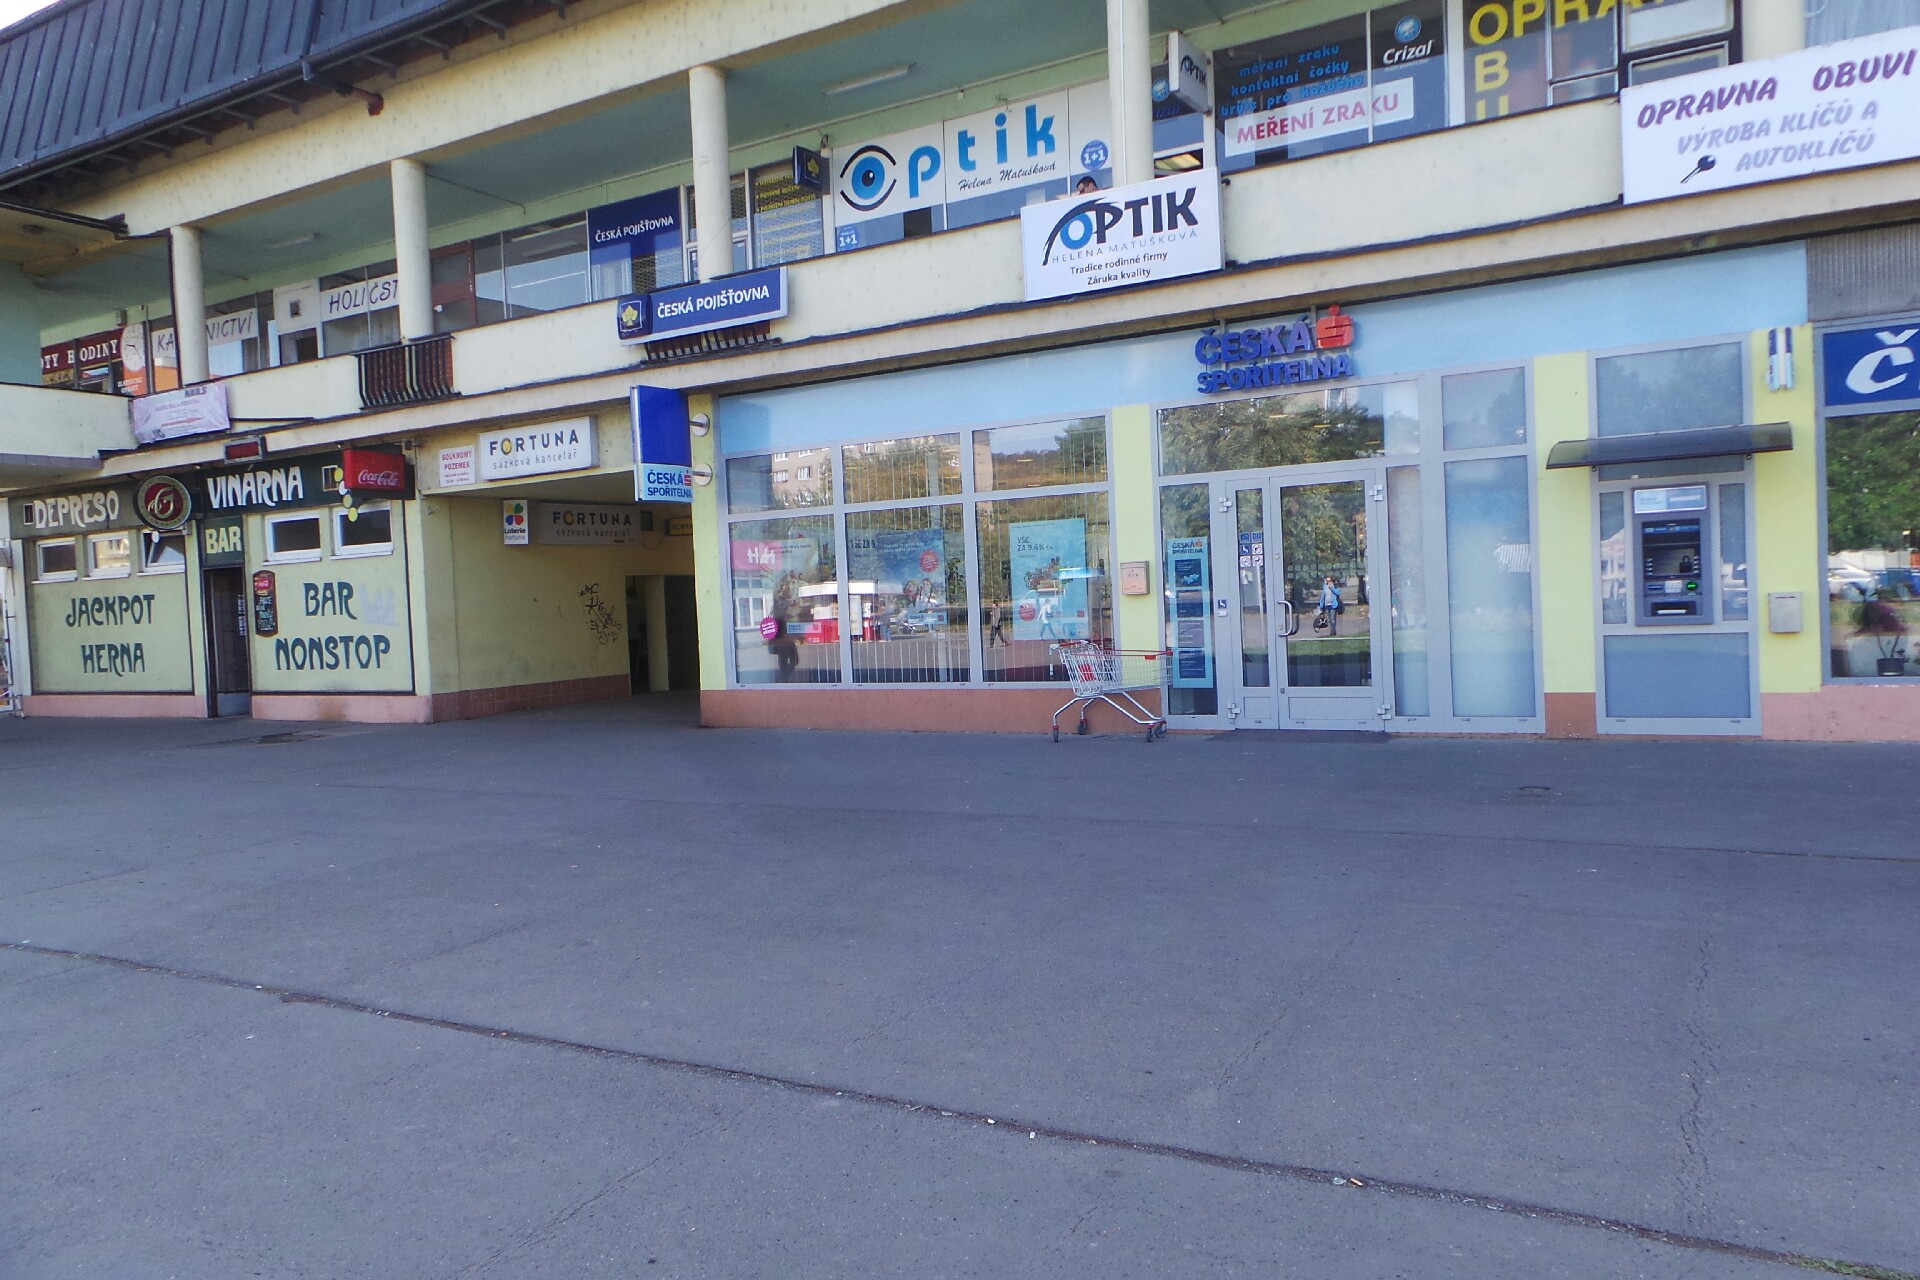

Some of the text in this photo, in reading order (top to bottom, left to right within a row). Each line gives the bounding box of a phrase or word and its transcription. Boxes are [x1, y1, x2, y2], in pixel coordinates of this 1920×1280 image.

[1299, 45, 1340, 63] zraku
[1383, 39, 1434, 66] Crizal
[1309, 60, 1349, 79] čočky
[1637, 48, 1917, 129] OPRAVNA OBUVI
[1236, 115, 1315, 145] MEŘENÍ
[1677, 117, 1771, 155] VÝROBA
[1861, 100, 1879, 119] A
[958, 177, 993, 192] Helena
[595, 214, 674, 243] ČESKÁ POJIŠŤOVNA
[1042, 186, 1199, 266] OPTIK
[1052, 247, 1104, 264] HELENA
[1069, 250, 1168, 275] Tradice rodinné firmy
[1087, 268, 1151, 285] Záruka kvality
[657, 285, 770, 319] ČESKÁ POJIŠŤOVNA
[1195, 314, 1316, 366] ČESKÁ
[1197, 353, 1354, 395] SPOŘITELNA
[489, 429, 579, 456] FORTUNA
[535, 449, 578, 465] kancelář
[206, 465, 305, 509] VINÁRNA
[647, 470, 684, 486] ČESKÁ
[647, 486, 692, 499] SPOŘITELNA
[33, 490, 120, 529] DEPRESO
[552, 510, 632, 527] FORTUNA
[205, 525, 242, 555] BAR
[504, 527, 526, 535] Loterie
[66, 594, 155, 628] JACKPOT
[303, 582, 357, 620] BAR
[81, 642, 146, 677] HERNA
[275, 634, 391, 671] NONSTOP
